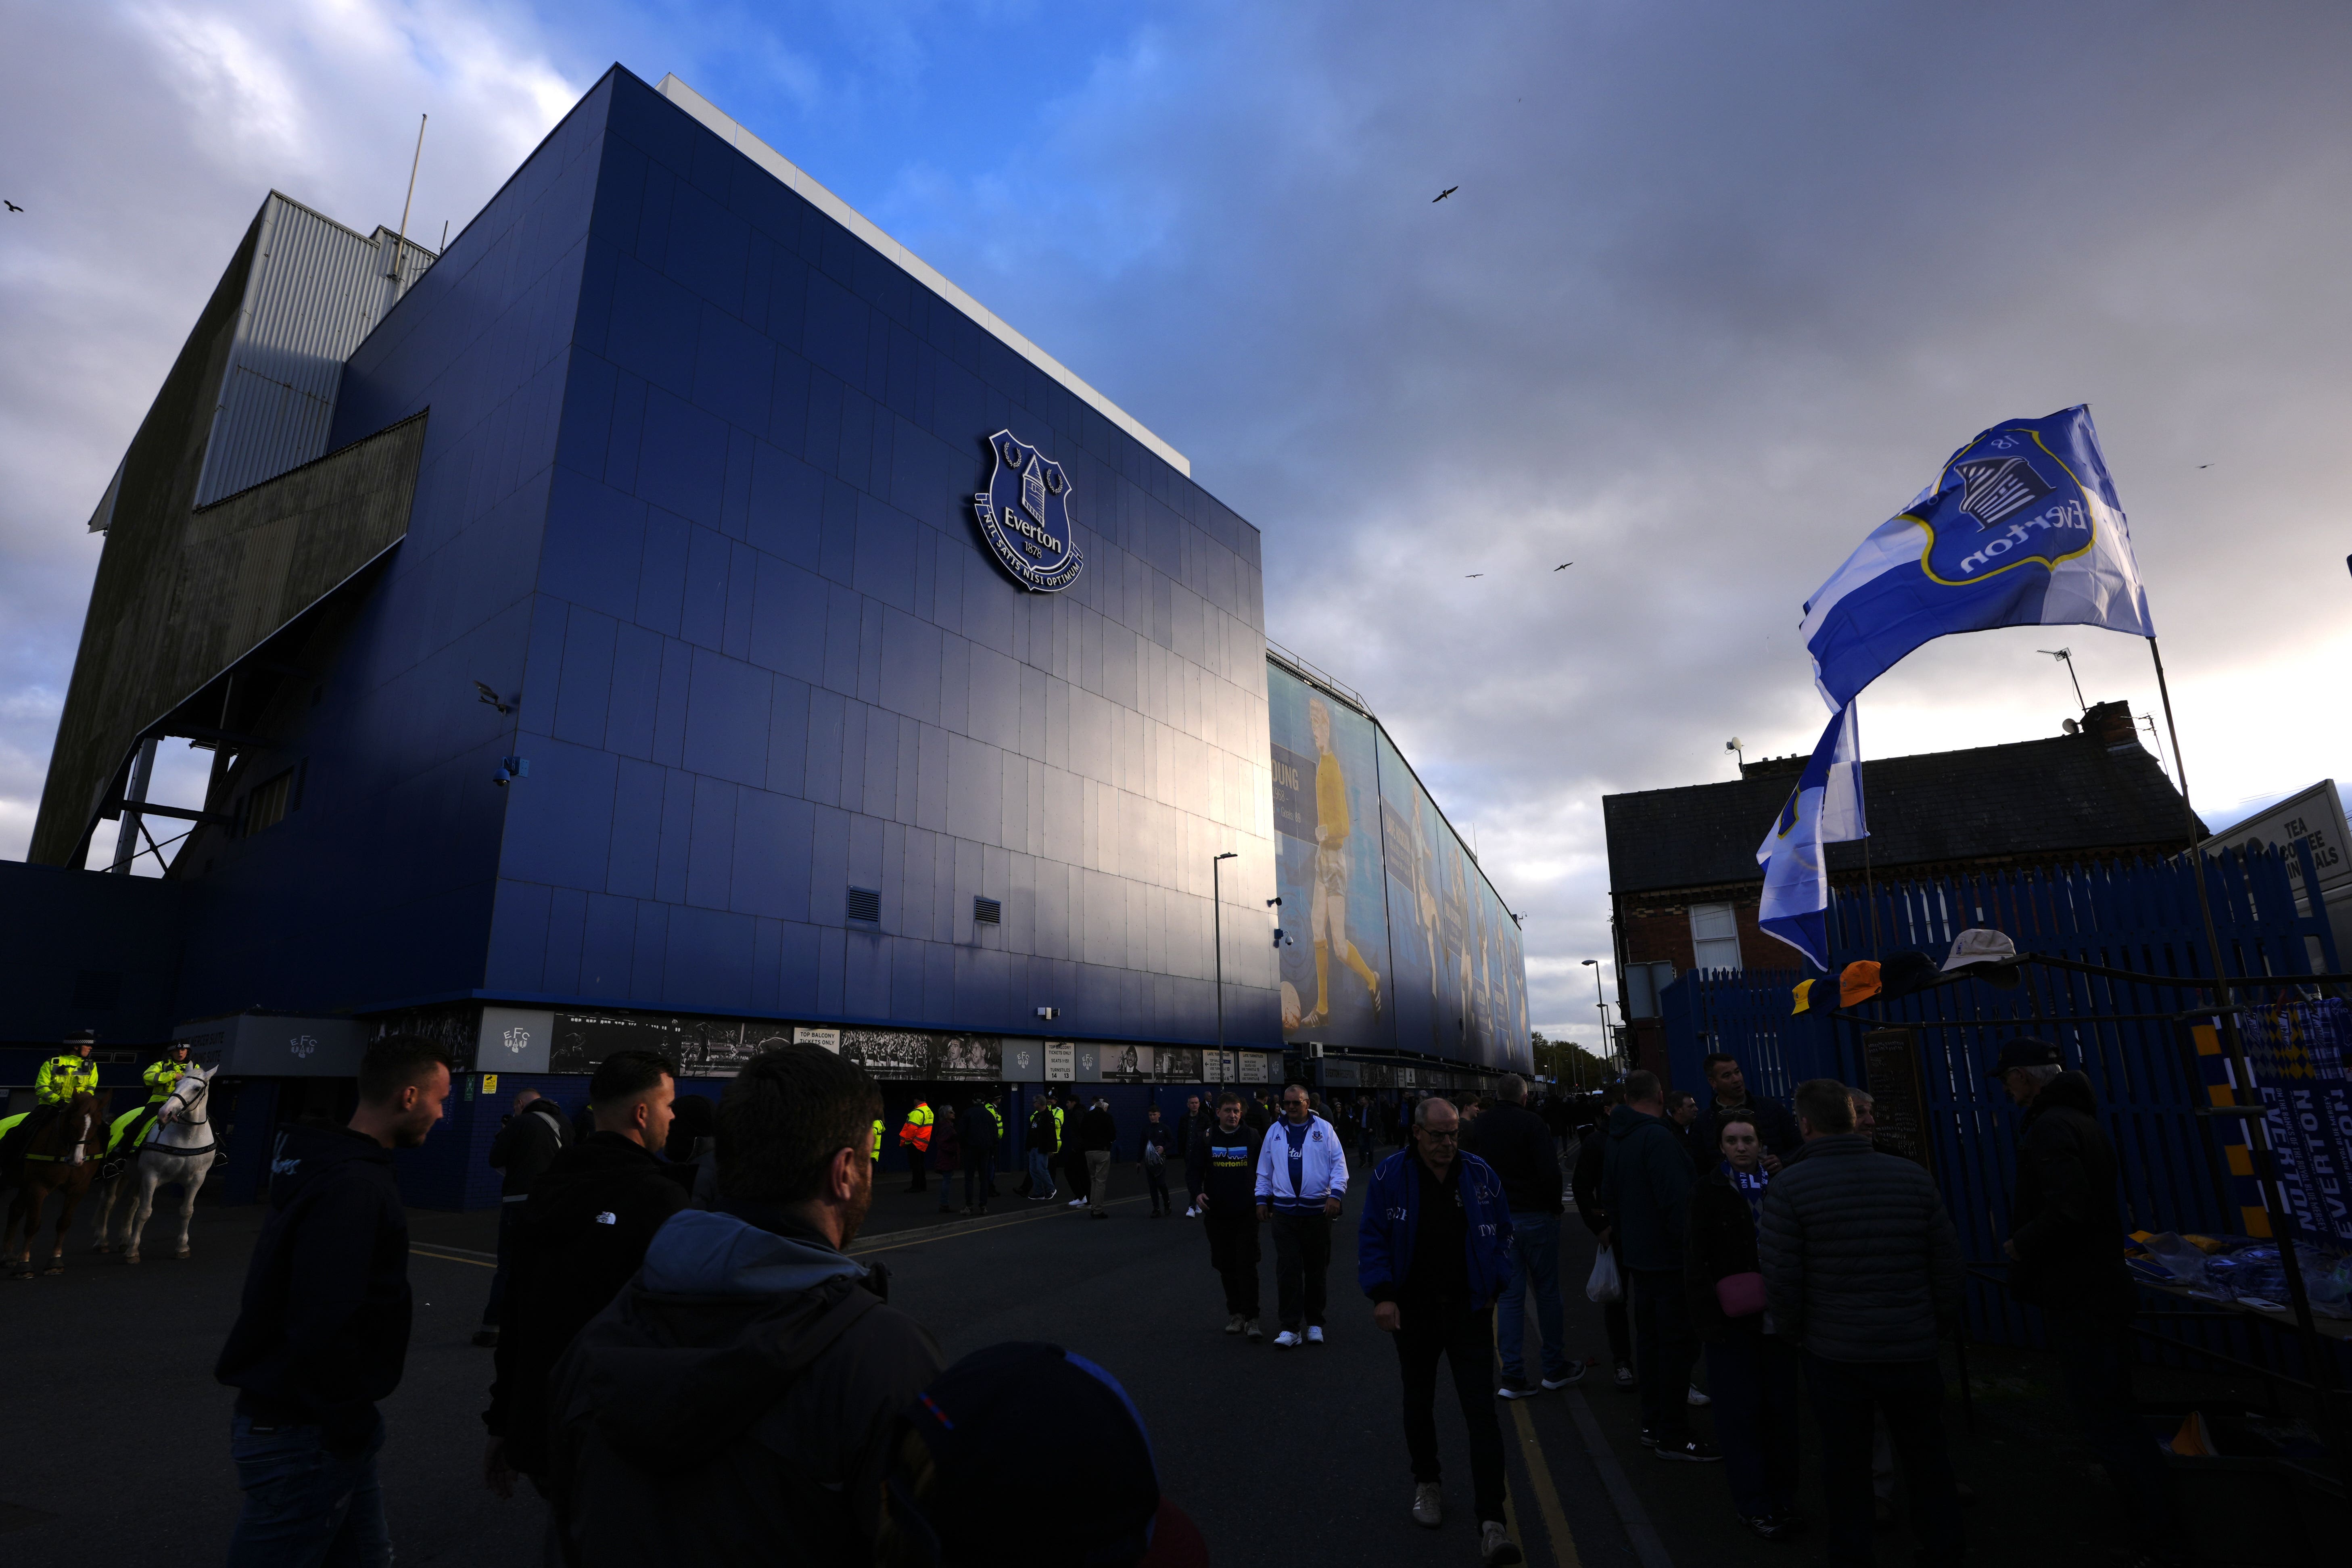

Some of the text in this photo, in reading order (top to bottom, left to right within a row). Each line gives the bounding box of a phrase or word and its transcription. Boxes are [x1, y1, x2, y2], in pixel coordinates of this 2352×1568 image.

[1004, 506, 1061, 553] Everton
[983, 514, 1080, 587] NIL SATIS NISI OPTIMUM
[1024, 541, 1042, 559] 1878
[1271, 758, 1299, 791] OUNG
[1273, 787, 1285, 802] 1968
[1295, 811, 1301, 823] 89
[2284, 817, 2308, 839] TEA
[2280, 830, 2325, 861] COEE
[2286, 847, 2339, 879] INALS
[210, 1031, 224, 1045] SUITE
[290, 1035, 317, 1046] EFC
[503, 1027, 530, 1040] EFC
[207, 1050, 222, 1063] SUITE
[1017, 1051, 1030, 1060] EFC
[1082, 1054, 1094, 1063] EFC
[2323, 1095, 2338, 1126] MERSEY
[2333, 1126, 2344, 1146] BLUE
[1213, 1159, 1248, 1167] evertonia
[2260, 1087, 2318, 1232] EVERTON
[2275, 1088, 2328, 1232] ON THE BANKS OF THE ROYAL BLUE MERSEY
[2293, 1089, 2352, 1239] EVERTON
